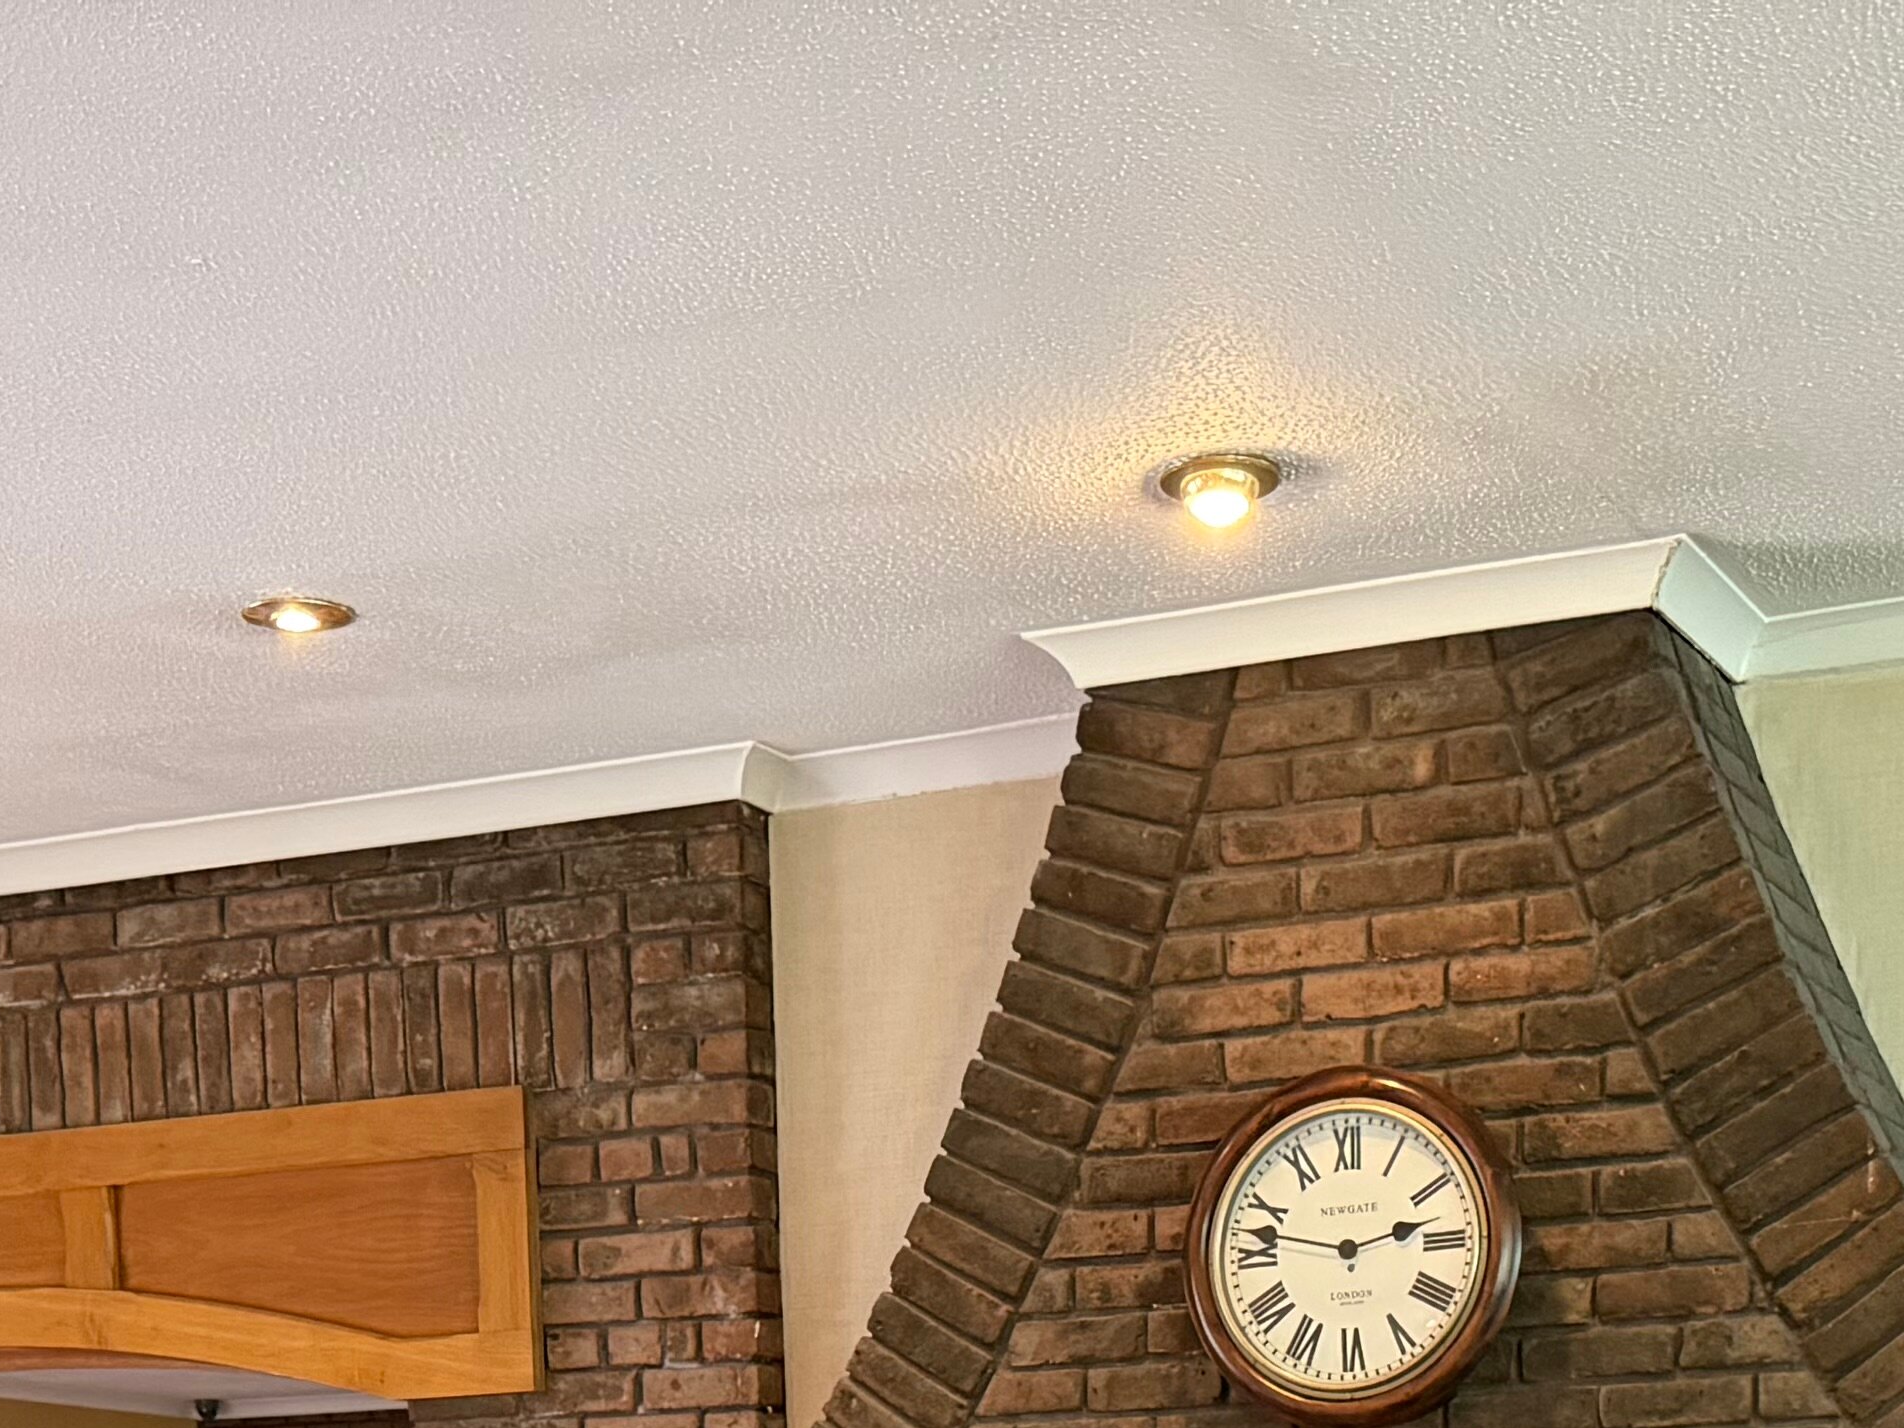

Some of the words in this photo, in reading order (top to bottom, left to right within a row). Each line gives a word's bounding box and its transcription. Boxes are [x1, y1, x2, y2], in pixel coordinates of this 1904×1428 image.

[1283, 1143, 1321, 1191] XI
[1333, 1126, 1361, 1172] XII
[1248, 1193, 1288, 1225] X
[1320, 1201, 1378, 1217] NEWGATE
[1410, 1173, 1451, 1208] II
[1423, 1229, 1465, 1251] III
[1248, 1281, 1295, 1334] VIII
[1330, 1289, 1373, 1301] LONDON
[1286, 1314, 1323, 1367] VII
[1341, 1327, 1365, 1372] VI
[1387, 1313, 1416, 1355] V
